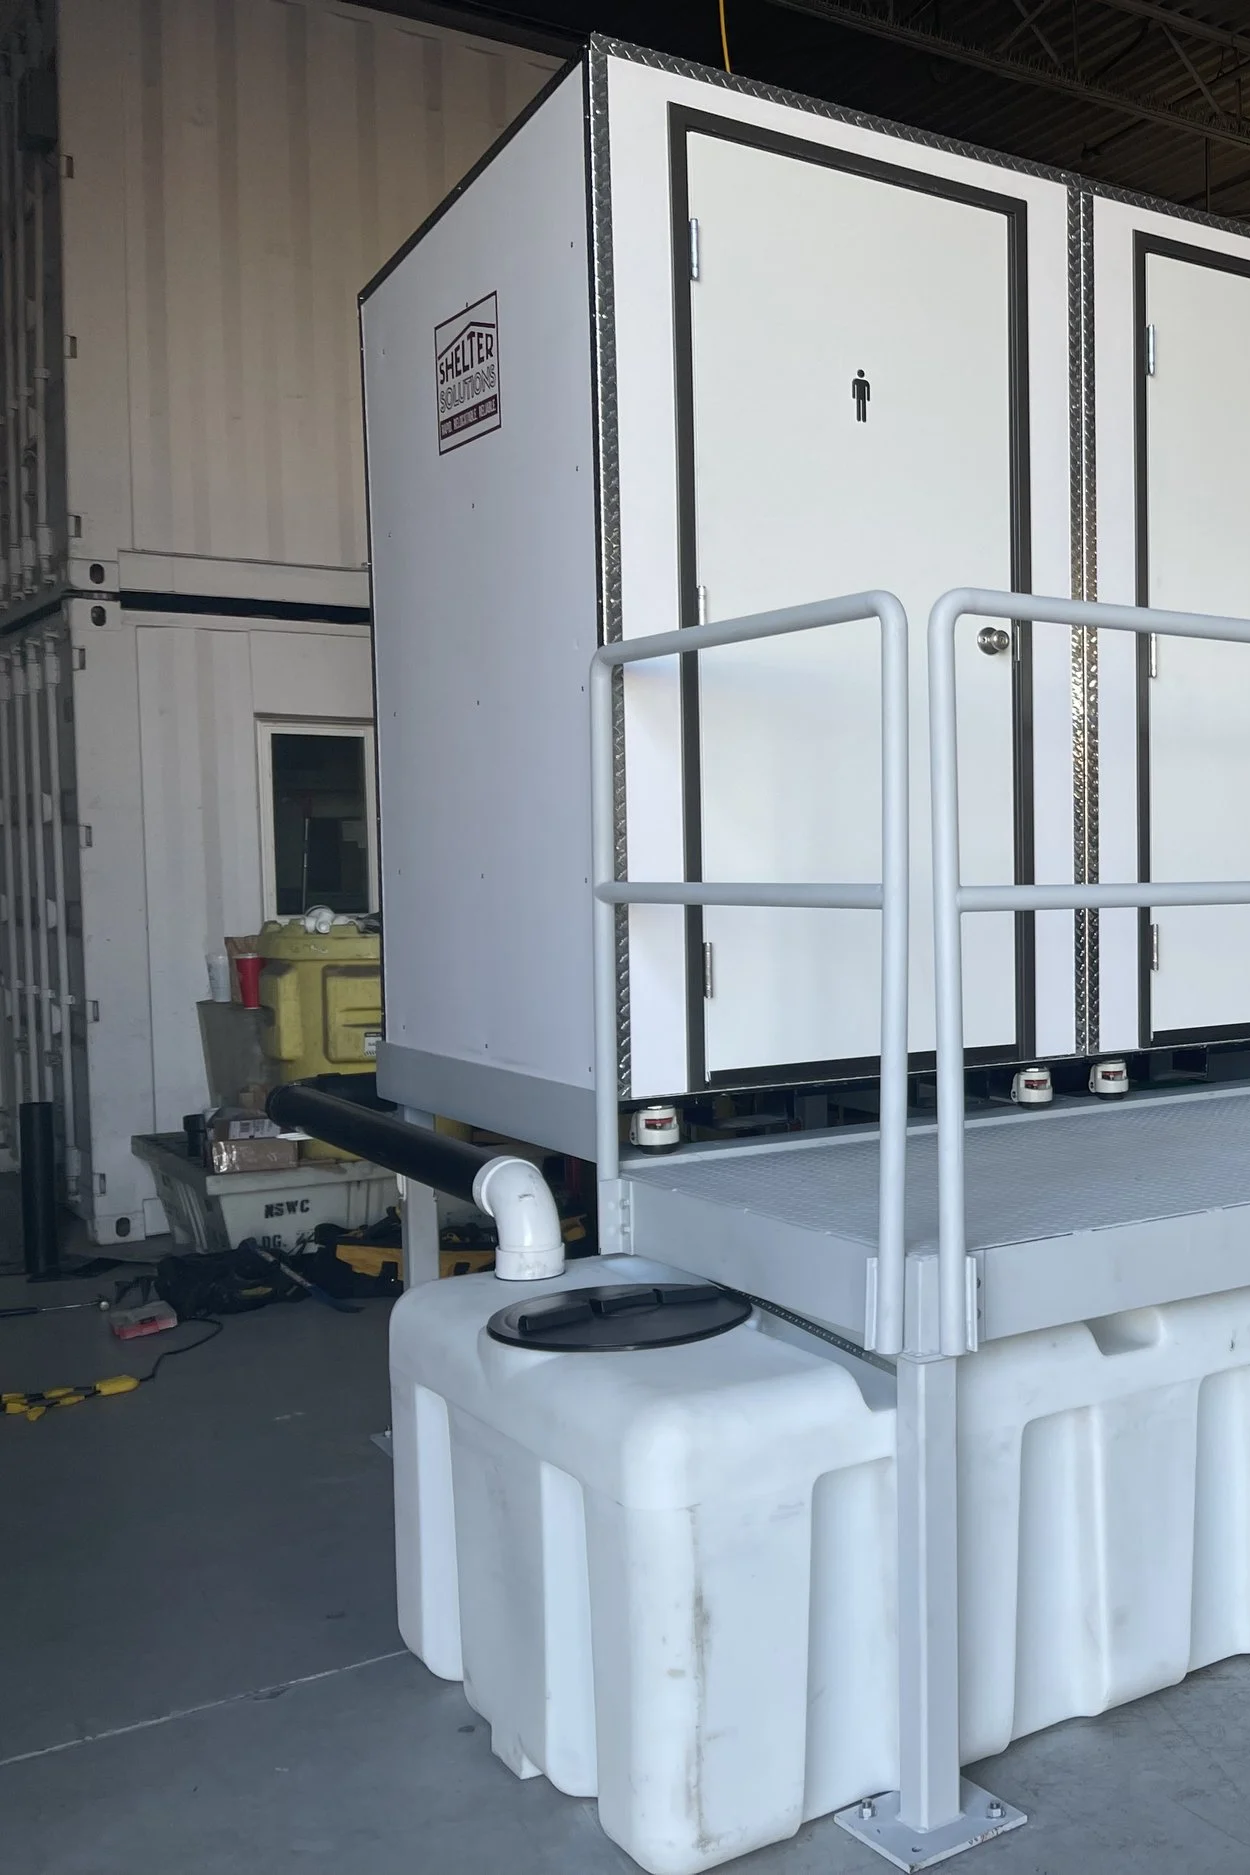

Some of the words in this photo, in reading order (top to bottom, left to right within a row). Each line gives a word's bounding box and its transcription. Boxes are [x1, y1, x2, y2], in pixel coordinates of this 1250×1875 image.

[439, 331, 494, 385] SHELTER
[440, 364, 496, 413] SOLUTIONS
[264, 1199, 310, 1219] NSWC
